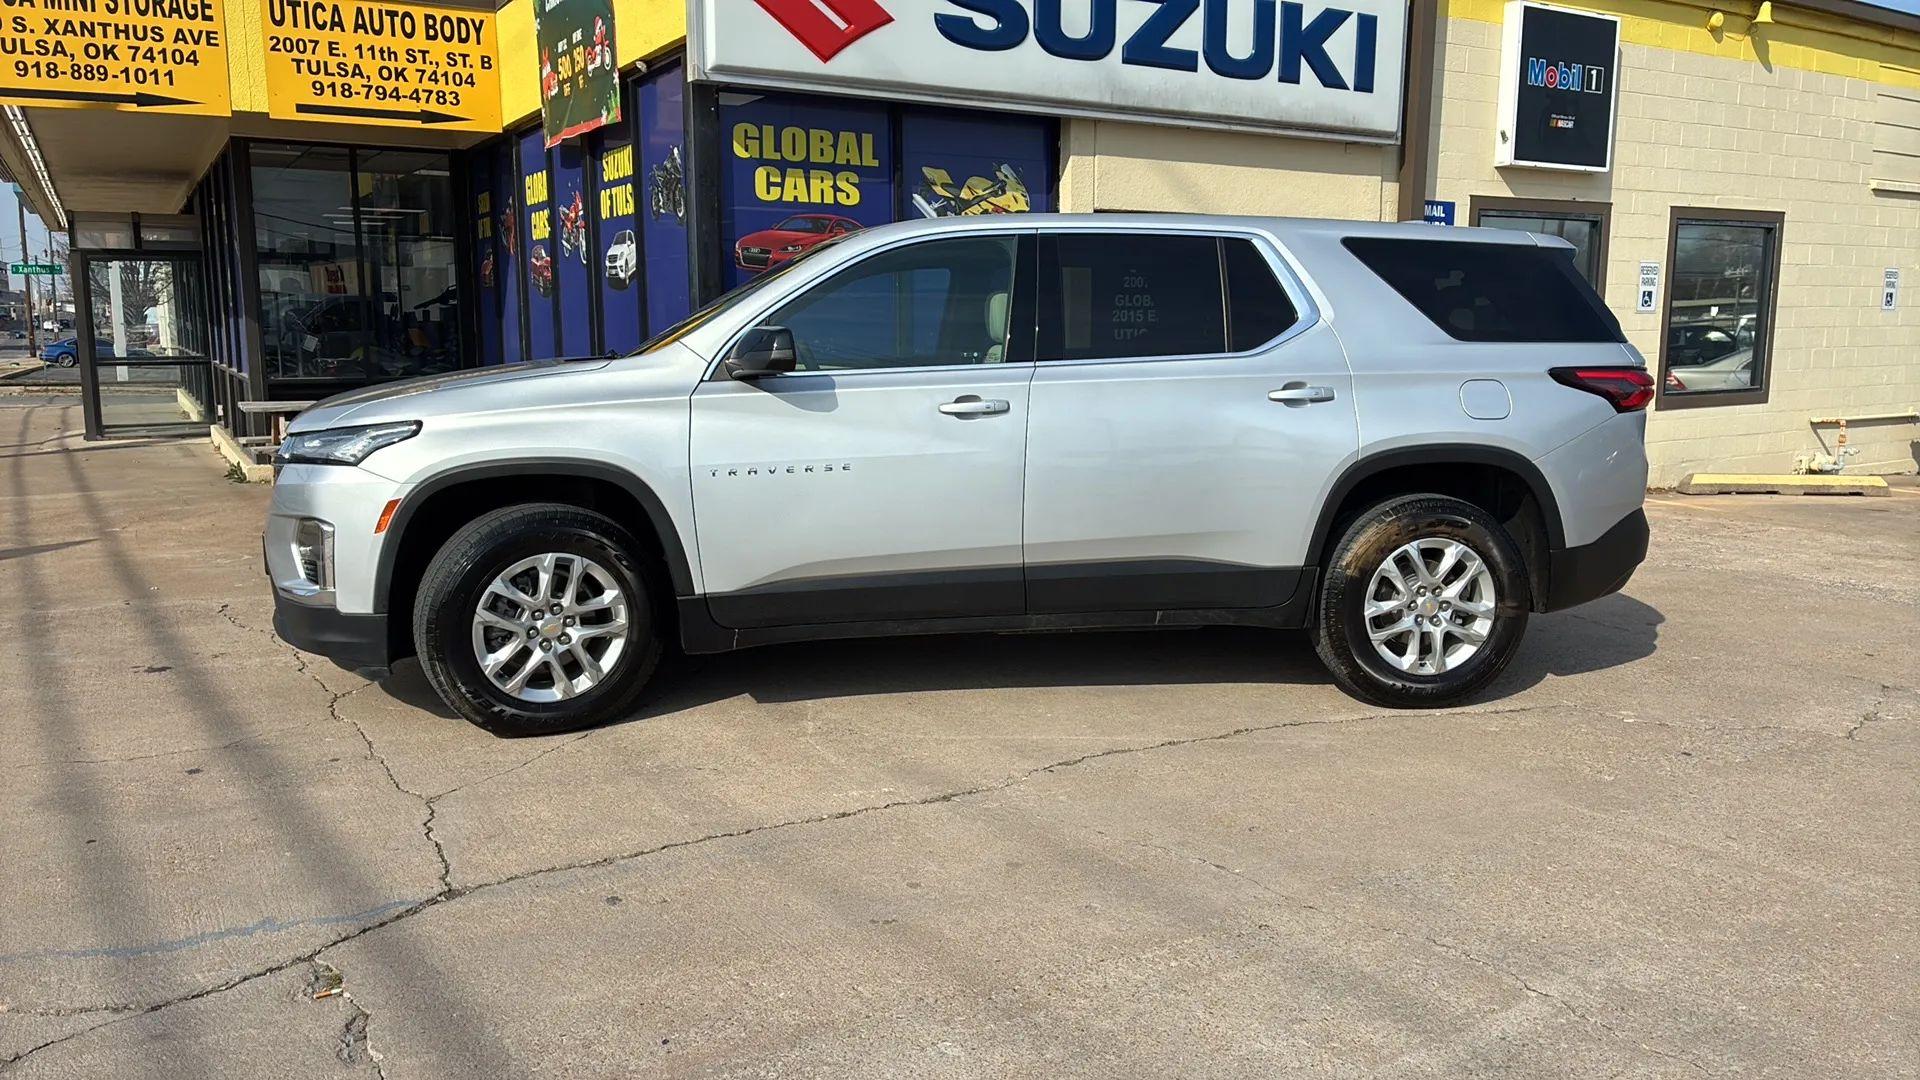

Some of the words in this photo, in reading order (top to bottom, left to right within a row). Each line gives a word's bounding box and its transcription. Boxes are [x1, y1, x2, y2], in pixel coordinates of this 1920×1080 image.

[12, 16, 35, 34] S.
[43, 17, 165, 42] XANTHUS
[173, 28, 220, 47] AVE
[269, 0, 346, 32] UTICA
[353, 6, 416, 39] AUTO
[423, 13, 485, 45] BODY
[84, 43, 120, 61] OK
[128, 45, 200, 66] 74104
[269, 35, 320, 55] 2007
[328, 41, 347, 57] E.
[354, 43, 398, 62] 11th
[446, 51, 473, 69] ST.
[480, 55, 493, 70] B
[933, 0, 1378, 93] SUZUKI
[14, 60, 175, 86] 918-889-1011
[291, 58, 371, 83] TULSA,
[378, 65, 409, 83] OK
[415, 69, 476, 88] 74104
[1527, 57, 1583, 91] Mobil
[311, 80, 462, 107] 918-794-4783
[732, 122, 880, 167] GLOBAL
[602, 144, 633, 183] SUZUKI
[754, 165, 861, 206] CARS
[600, 189, 611, 220] OF
[611, 183, 635, 218] TULS
[1424, 204, 1446, 218] MAIL
[18, 265, 50, 274] Xanthus
[1112, 309, 1144, 323] 2015
[710, 463, 852, 477] TRAVERSE
